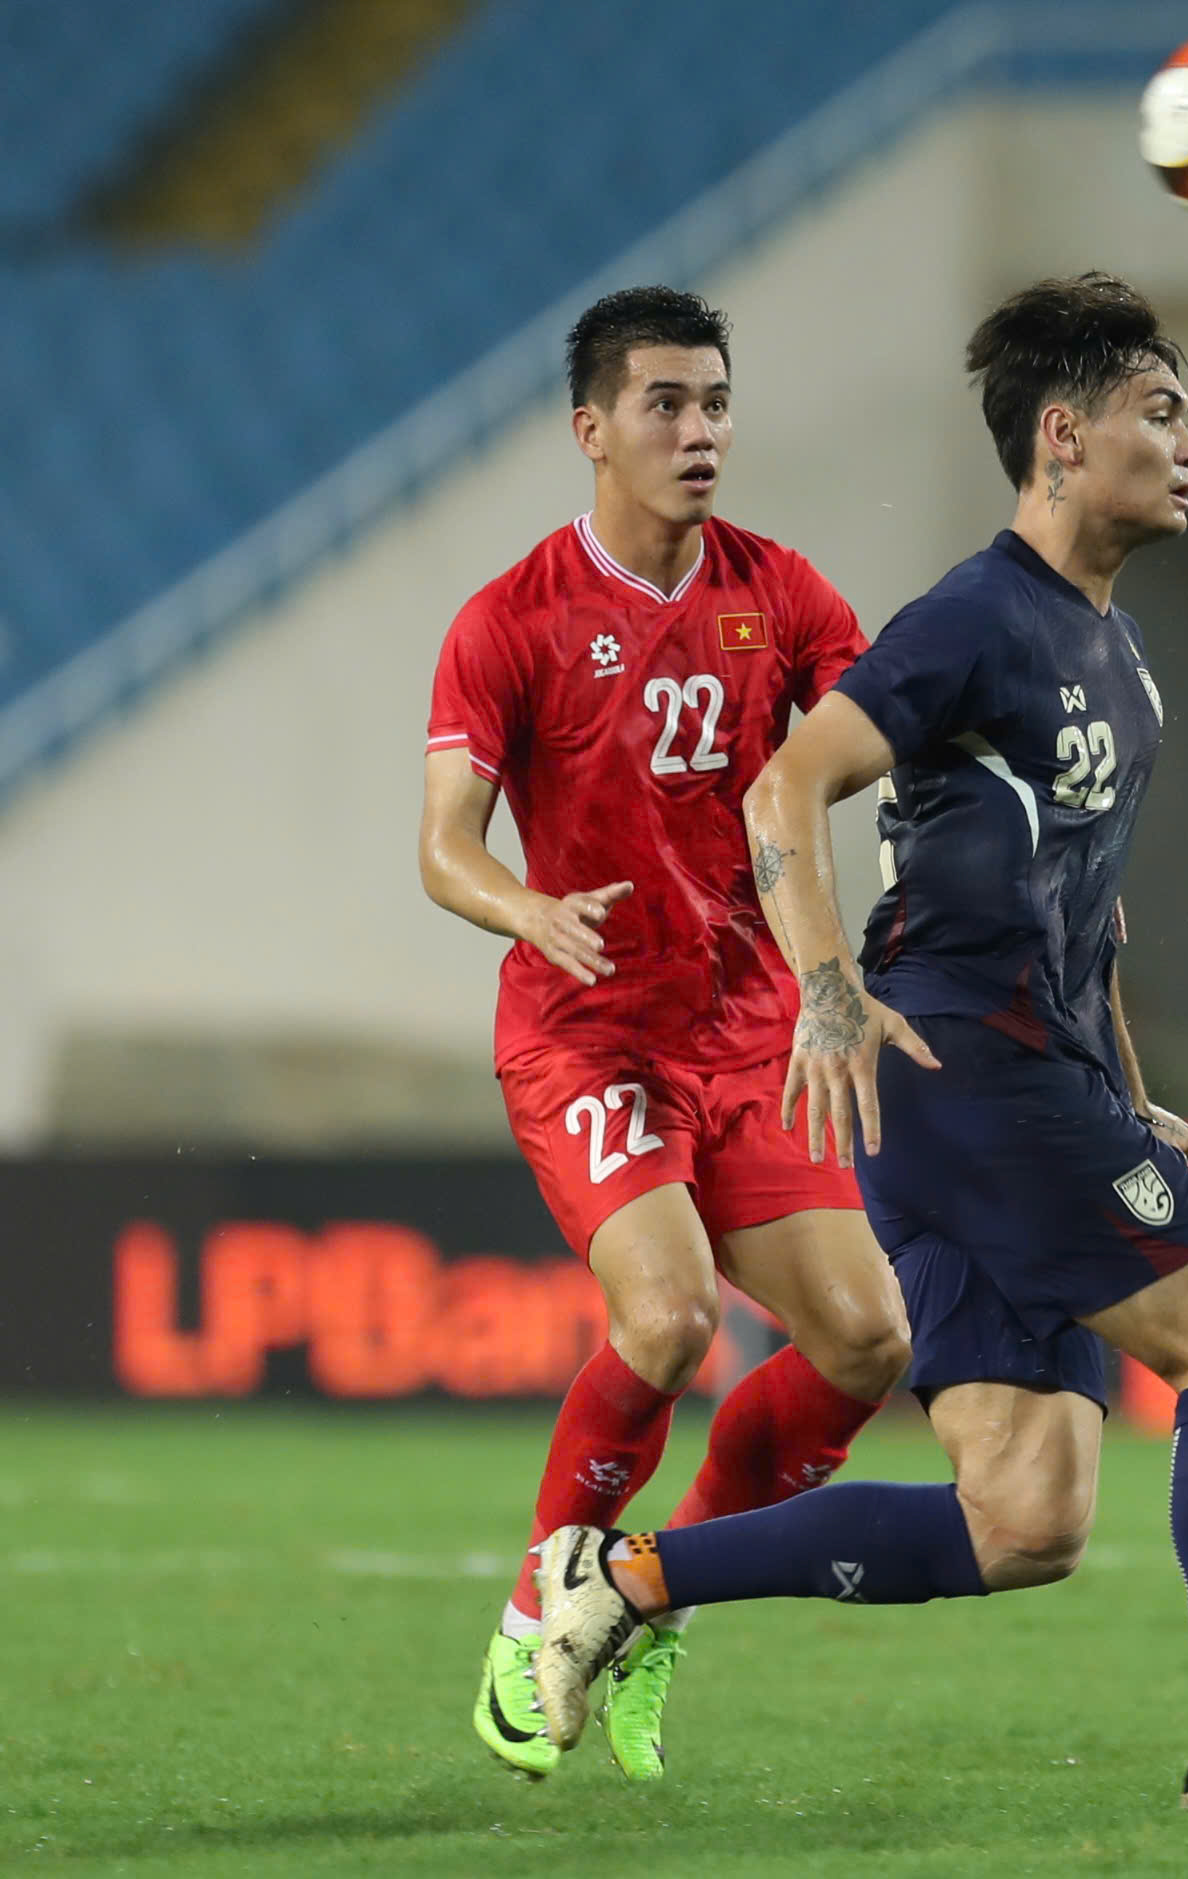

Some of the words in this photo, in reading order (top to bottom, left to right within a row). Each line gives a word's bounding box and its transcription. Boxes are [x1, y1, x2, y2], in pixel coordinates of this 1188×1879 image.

[644, 674, 729, 775] 22
[1052, 721, 1117, 811] 22
[565, 1083, 665, 1184] 22
